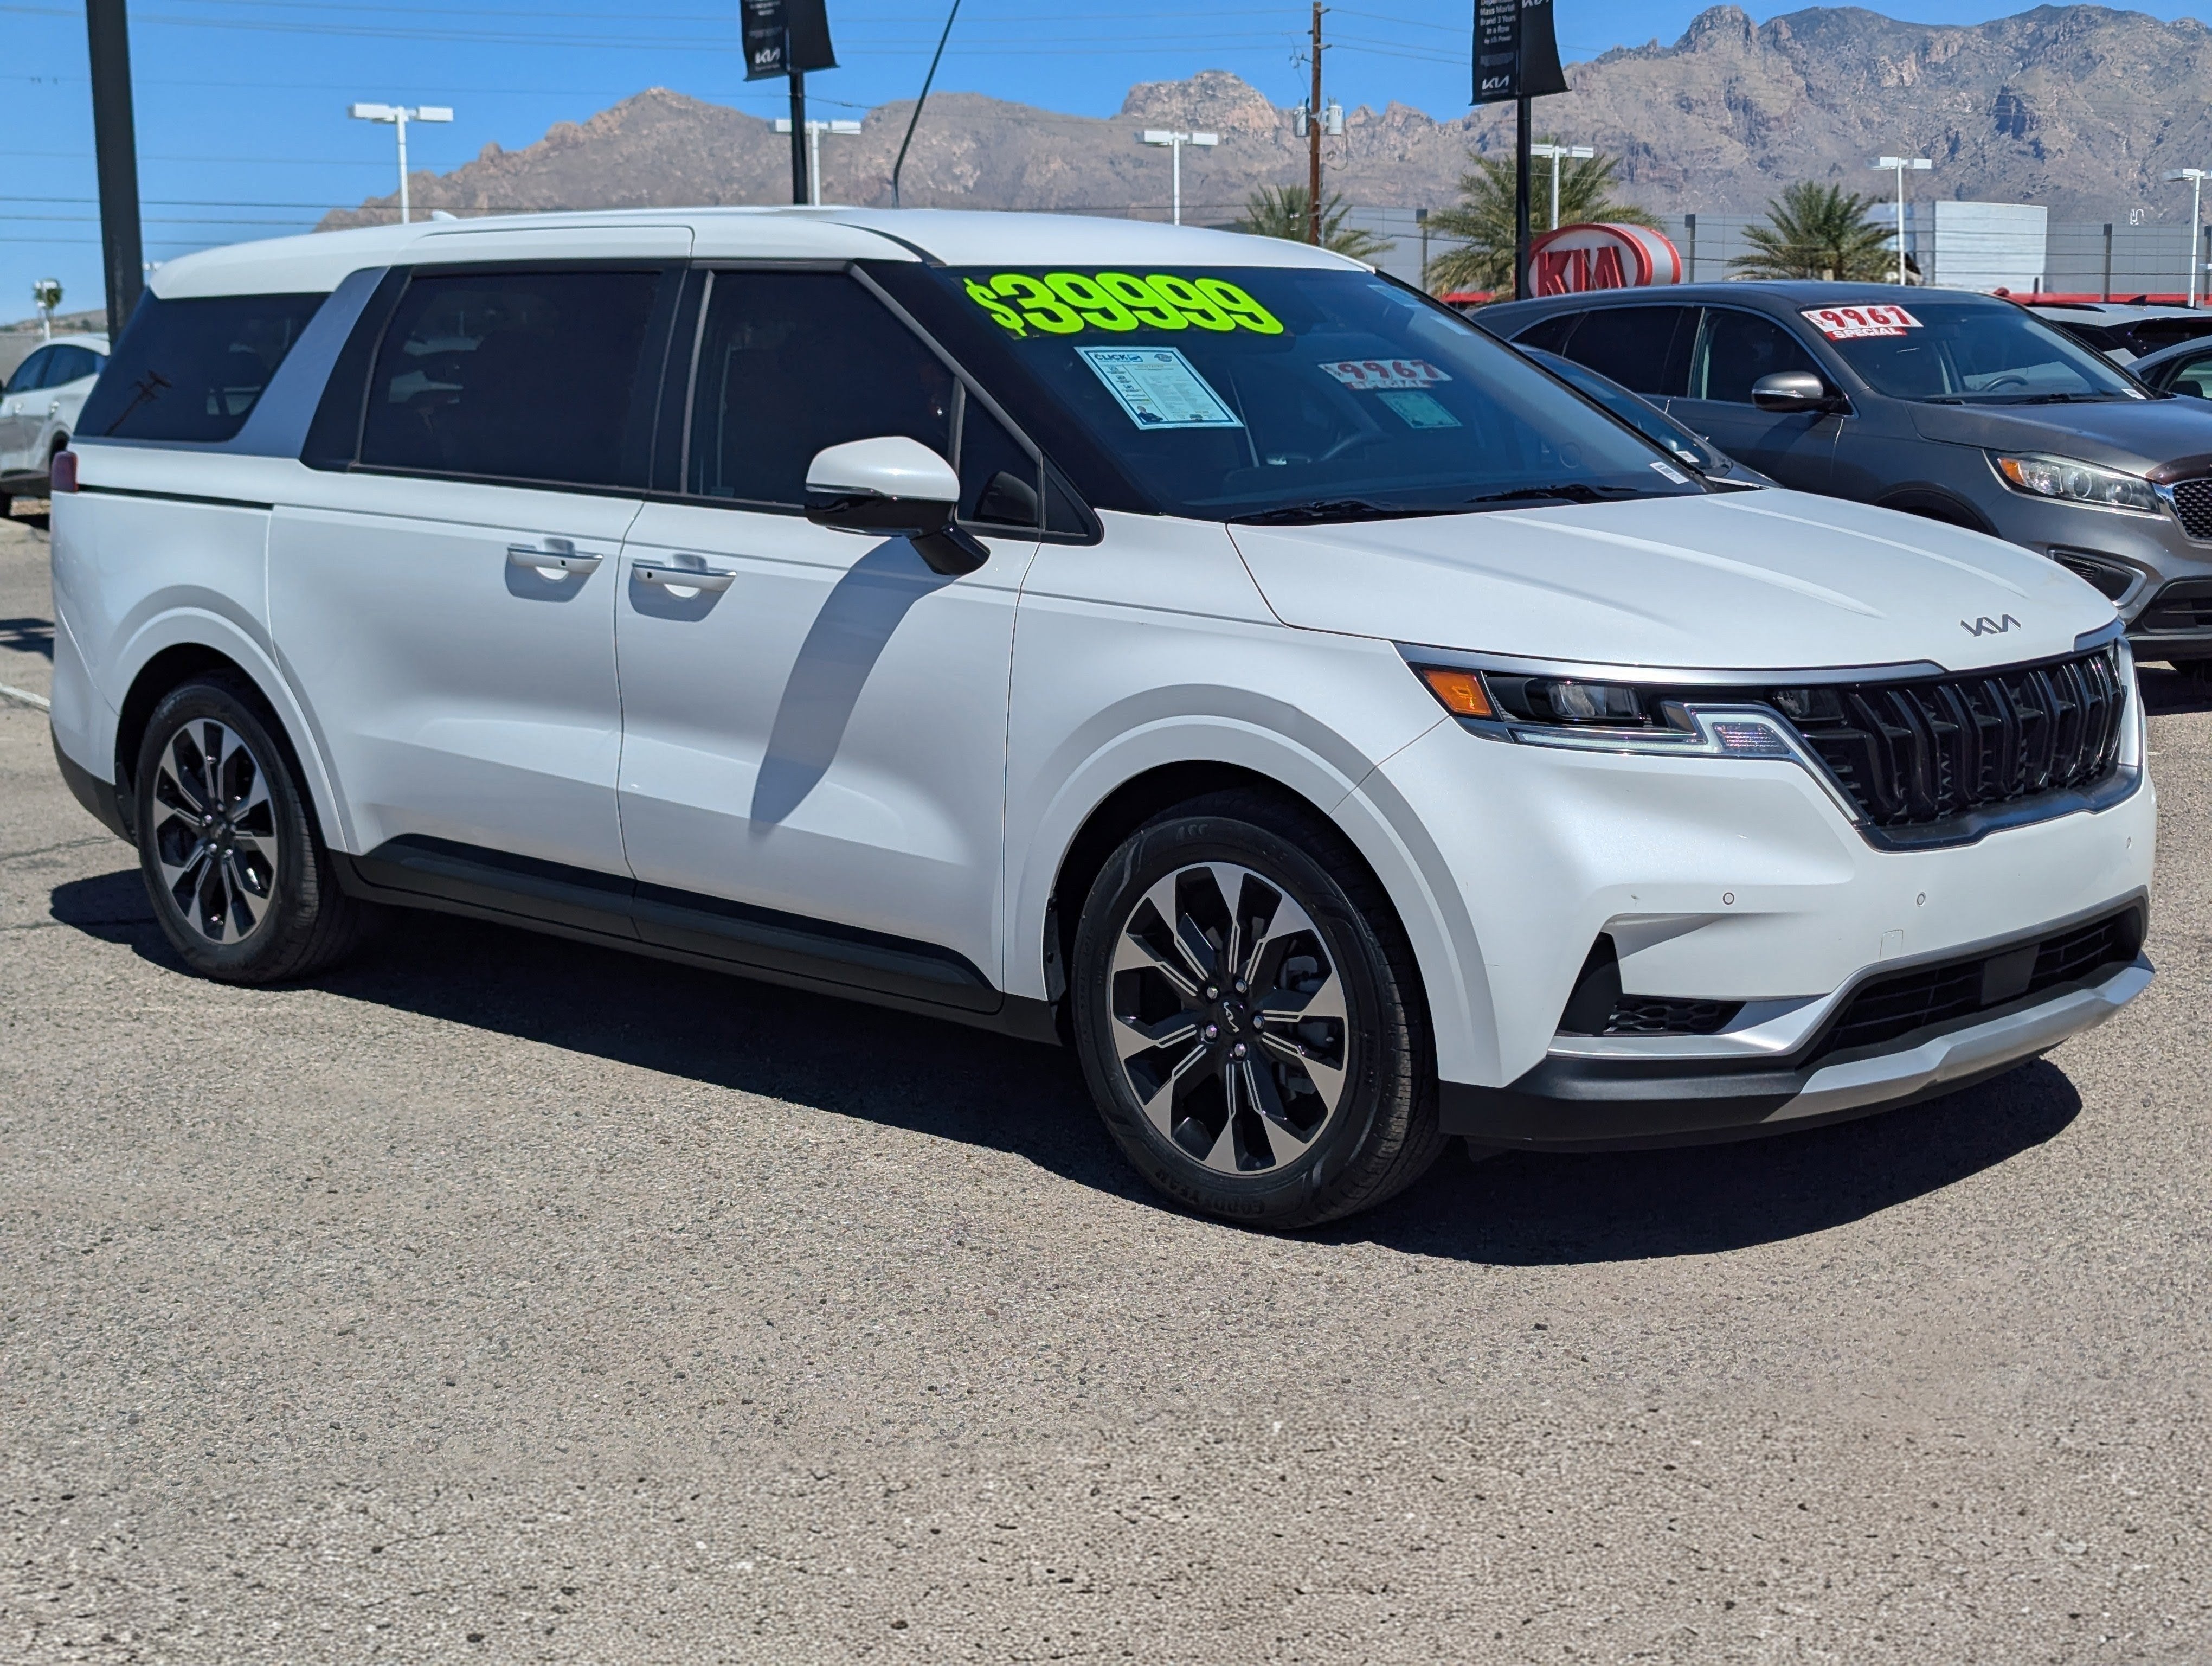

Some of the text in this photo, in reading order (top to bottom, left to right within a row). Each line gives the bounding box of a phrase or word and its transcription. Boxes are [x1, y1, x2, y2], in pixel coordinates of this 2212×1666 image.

[1482, 75, 1509, 90] KIA
[1538, 246, 1627, 297] KIA
[963, 272, 1283, 337] $39999
[1834, 326, 1904, 339] SPECIAL
[1960, 614, 2021, 637] KIA
